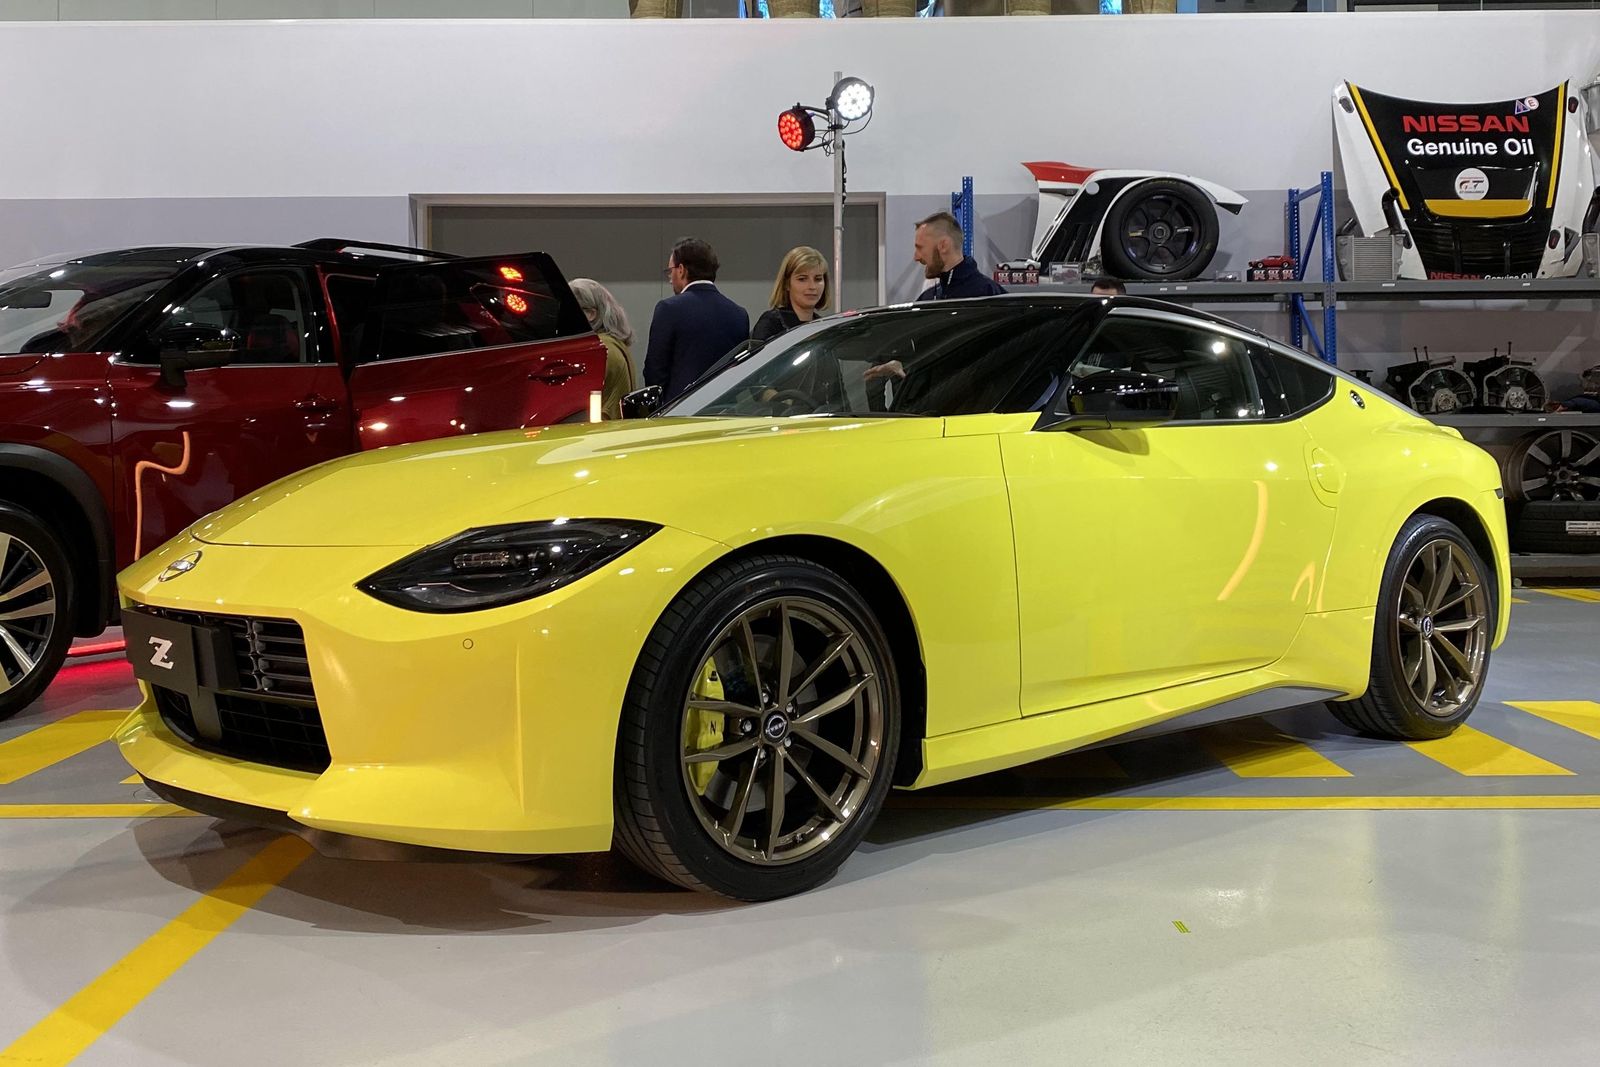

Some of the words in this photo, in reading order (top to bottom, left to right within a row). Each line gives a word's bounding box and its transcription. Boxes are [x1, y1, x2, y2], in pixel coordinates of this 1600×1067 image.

[1402, 115, 1530, 132] NISSAN
[1407, 138, 1498, 155] Genuine
[1504, 138, 1534, 155] Oil
[148, 636, 174, 669] Z
